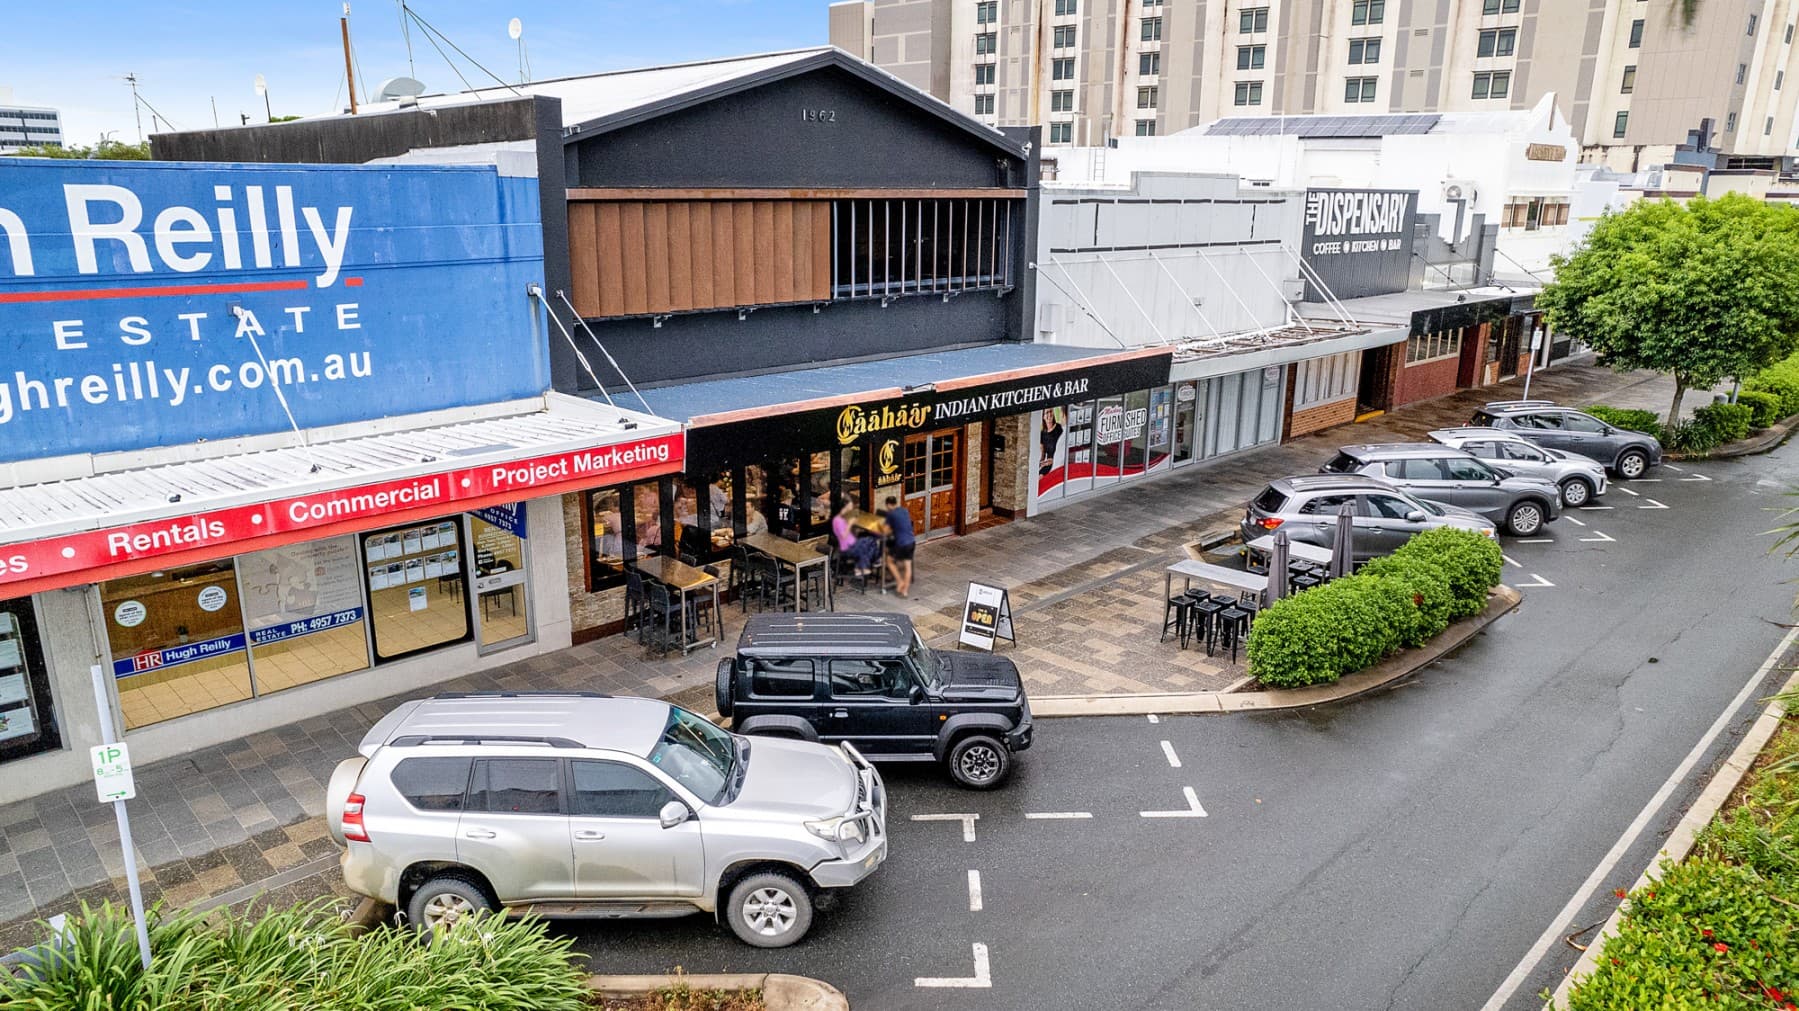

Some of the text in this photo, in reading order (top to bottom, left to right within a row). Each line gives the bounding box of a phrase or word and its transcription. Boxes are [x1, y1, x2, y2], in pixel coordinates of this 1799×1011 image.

[803, 109, 836, 122] 1962
[1305, 192, 1319, 226] THE
[1315, 192, 1409, 236] DISPENSARY
[63, 184, 353, 288] Reilly
[1313, 239, 1402, 255] COFFEE KITCHEN BAR
[53, 303, 361, 350] ESTATE
[935, 396, 988, 419] INDIAN
[990, 384, 1052, 410] KITCHEN
[1053, 382, 1063, 398] &
[1064, 378, 1089, 394] BAR
[1101, 409, 1146, 433] FURNSHED
[107, 518, 225, 556] Rentals
[289, 478, 440, 524] Commercial
[492, 461, 569, 488] Project
[574, 442, 669, 474] Marketing
[255, 628, 278, 637] REAL
[290, 610, 357, 635] PH: 4957 7373
[256, 631, 286, 643] ESTATE
[136, 639, 232, 670] HR Hugh Reilly
[98, 749, 121, 764] 1P
